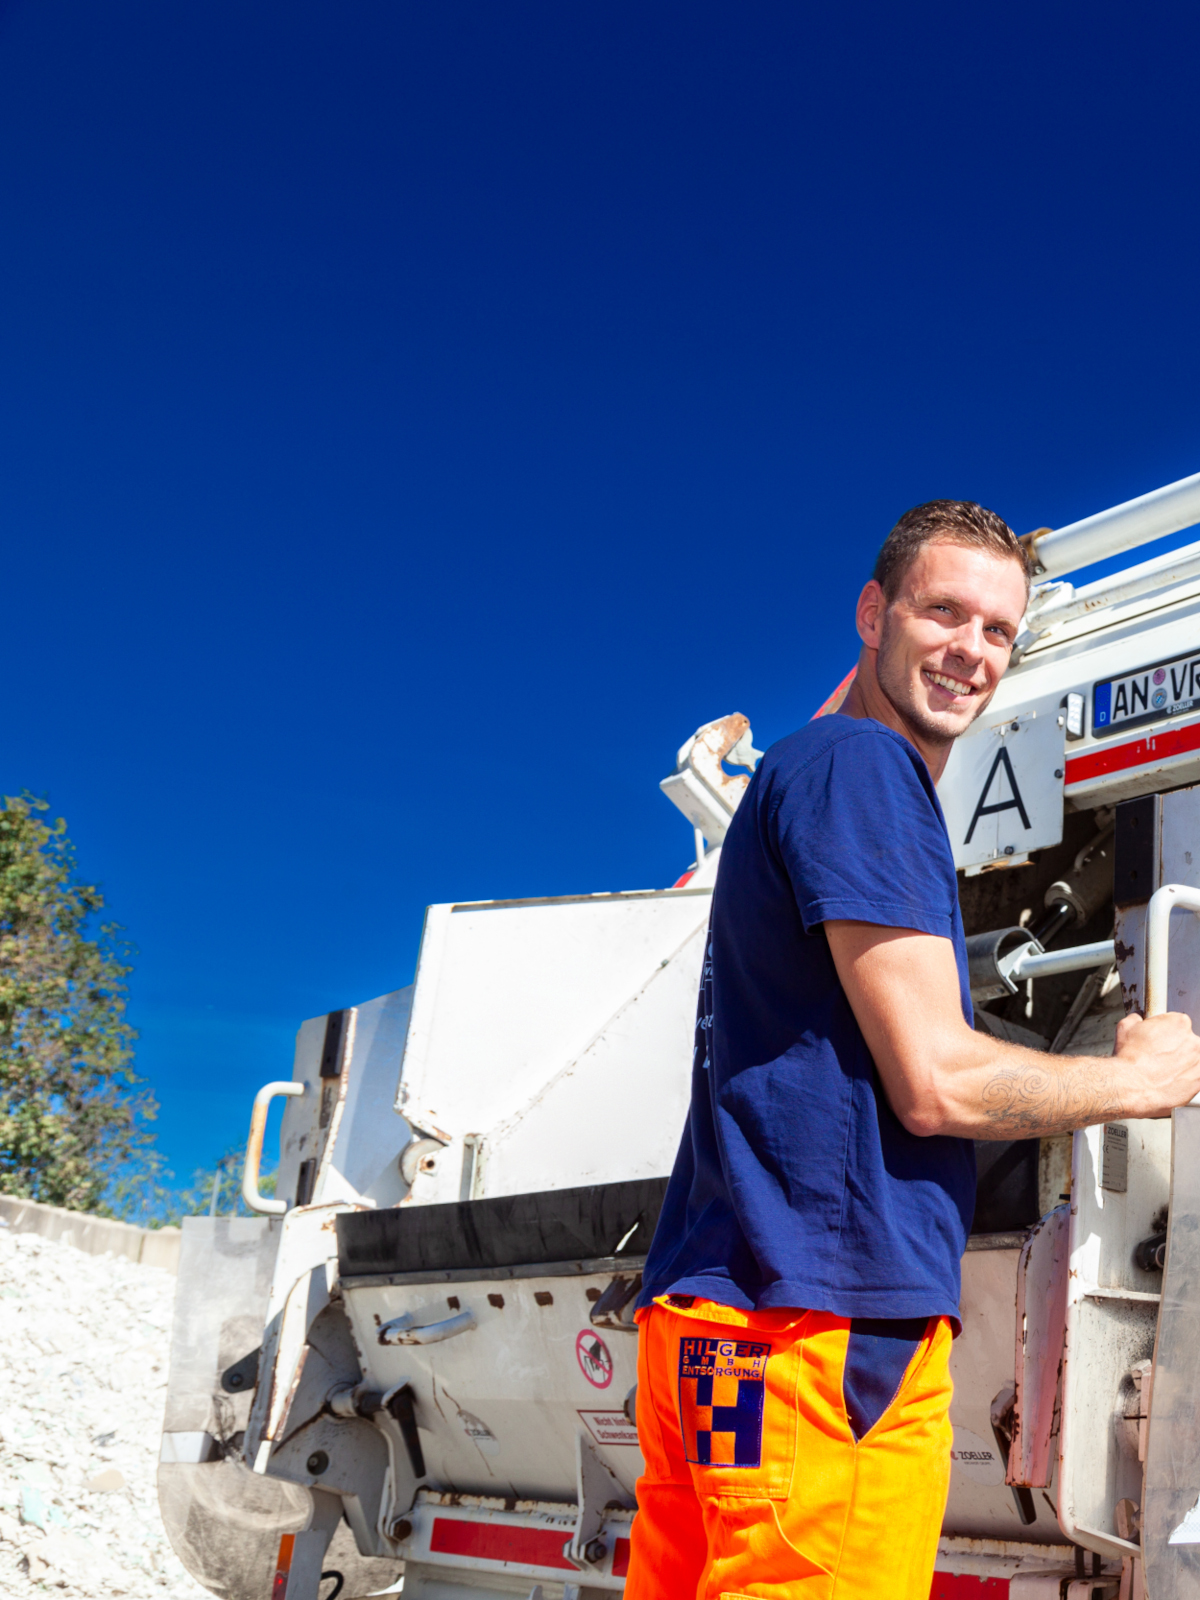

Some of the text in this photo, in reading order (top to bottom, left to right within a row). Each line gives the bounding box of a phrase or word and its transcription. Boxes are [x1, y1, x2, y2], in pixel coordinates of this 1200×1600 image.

[1112, 676, 1149, 720] AN
[1100, 712, 1106, 722] D
[963, 746, 1032, 845] A
[1108, 1126, 1127, 1139] ZOELLER
[684, 1340, 764, 1358] HILGER
[682, 1365, 760, 1378] ENTSORGUNG
[593, 1417, 614, 1426] Nicht
[957, 1451, 995, 1460] ZOELLER
